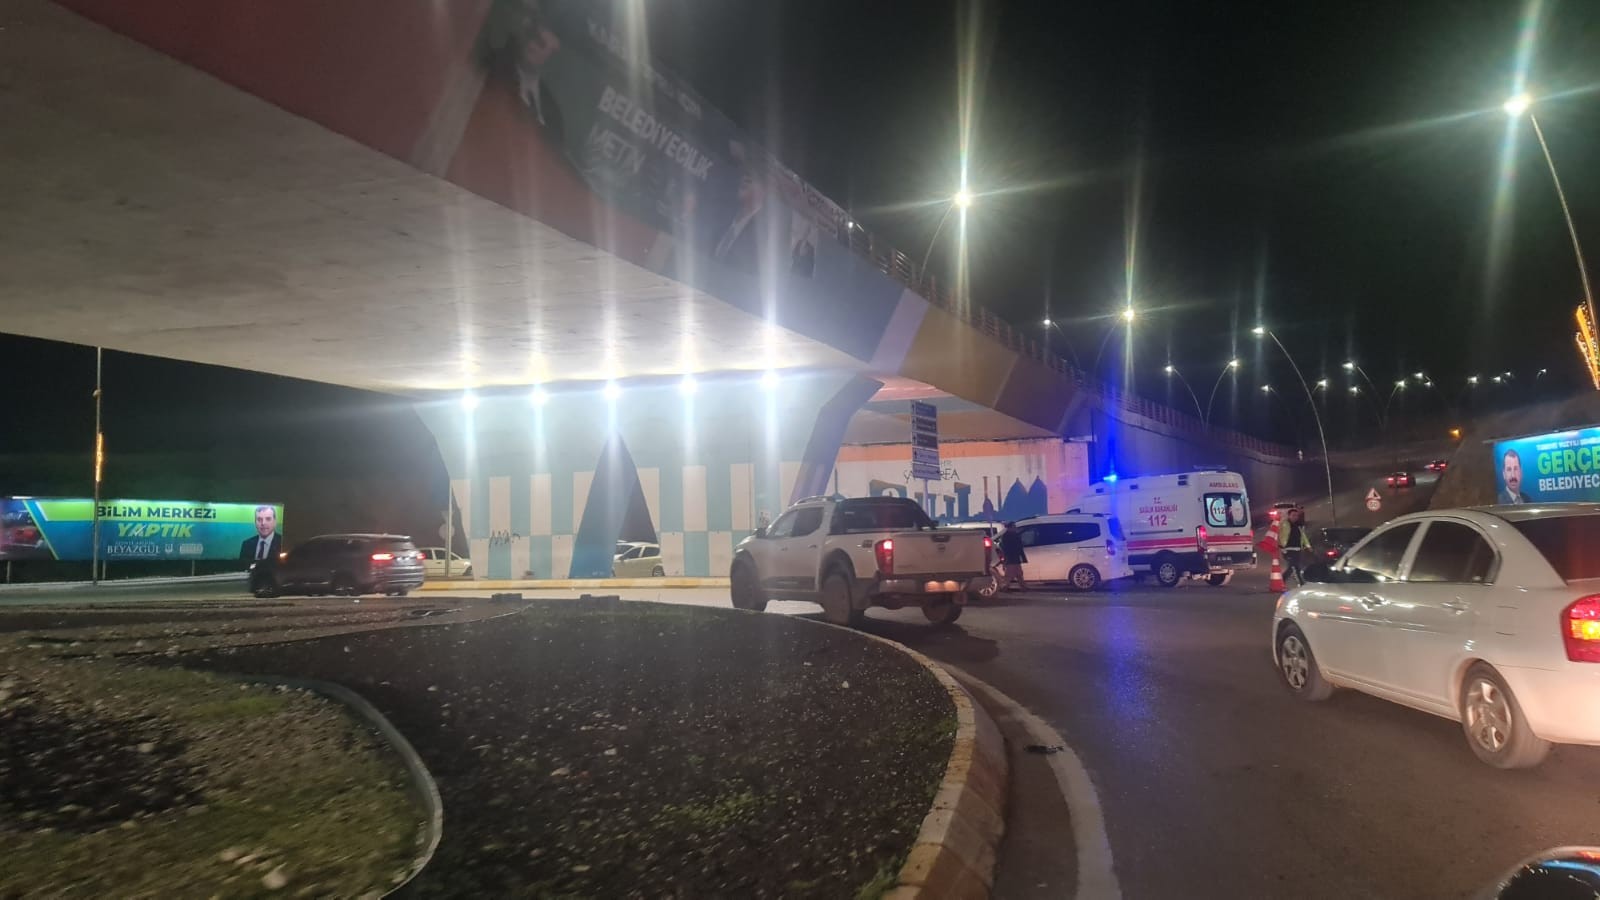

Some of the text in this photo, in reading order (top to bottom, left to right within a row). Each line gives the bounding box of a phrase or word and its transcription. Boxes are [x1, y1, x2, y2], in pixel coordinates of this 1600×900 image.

[597, 86, 713, 181] BELEDİYECİLİK
[97, 505, 216, 519] BİLİM MERKEZİ
[1213, 507, 1225, 515] 112
[1148, 514, 1168, 527] 112
[117, 523, 195, 538] YAPTIK
[107, 543, 160, 554] BEYAZGÜL
